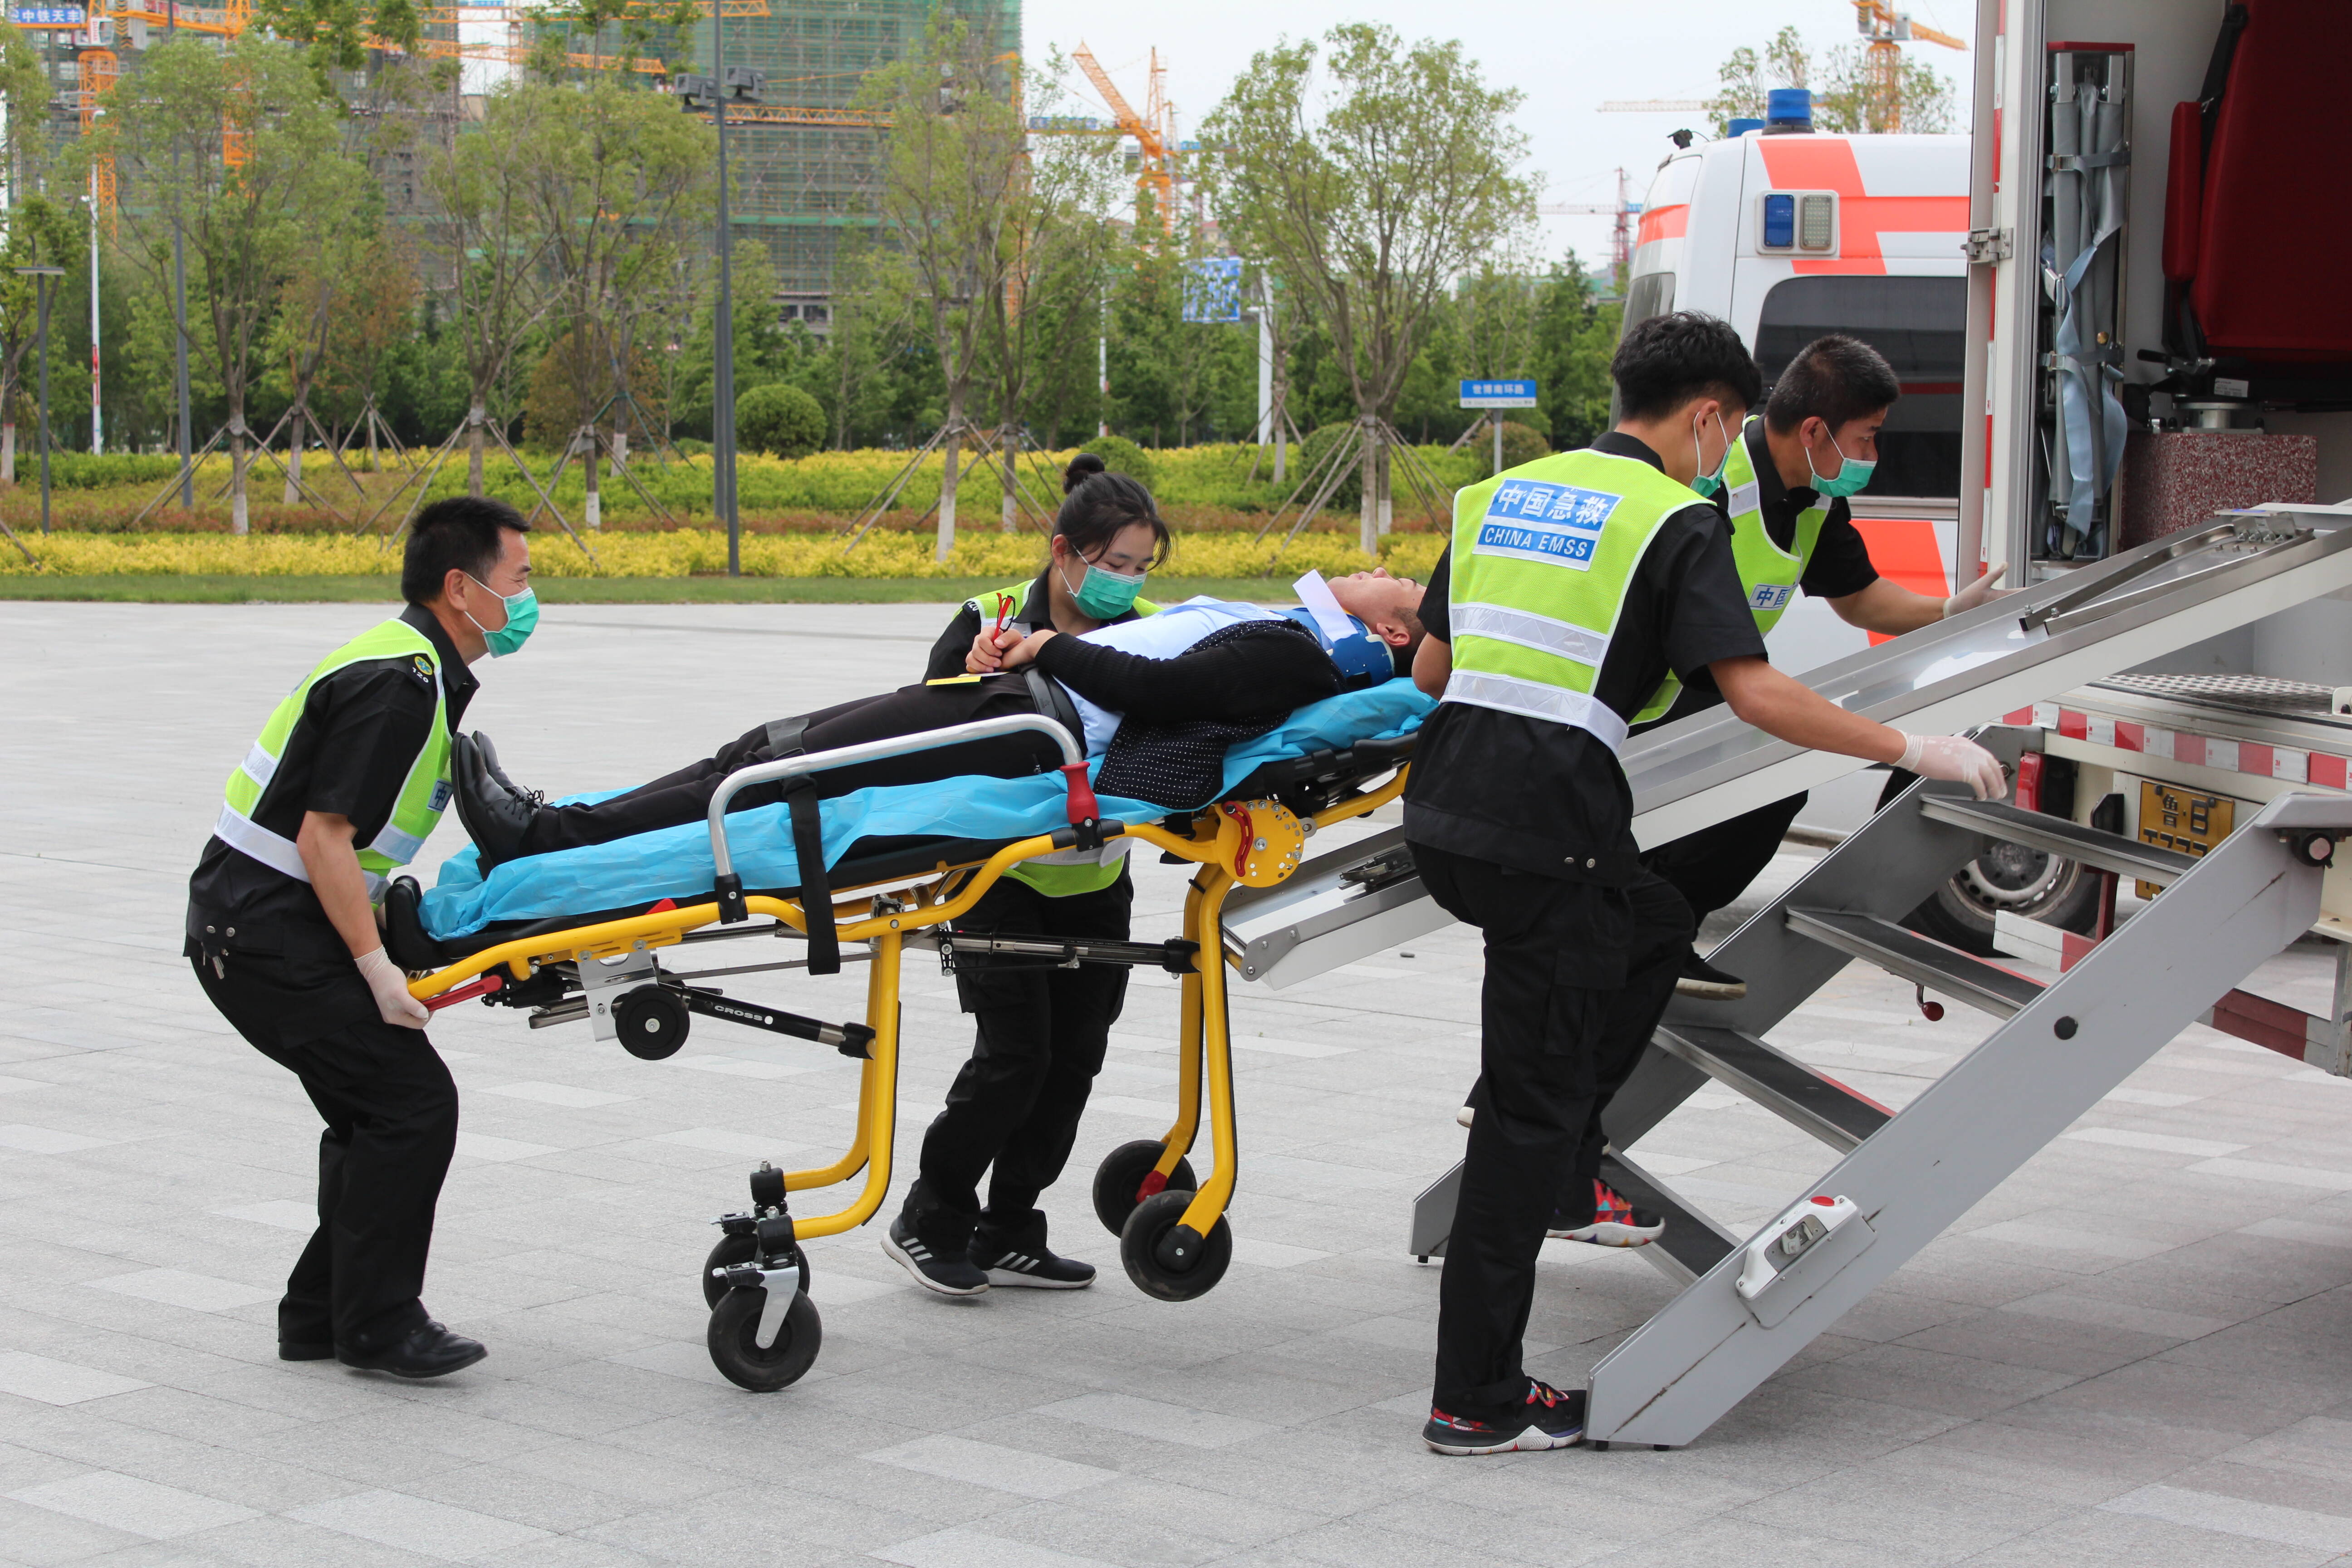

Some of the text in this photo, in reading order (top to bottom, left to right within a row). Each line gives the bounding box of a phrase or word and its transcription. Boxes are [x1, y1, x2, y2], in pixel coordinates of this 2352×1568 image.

[1498, 484, 1609, 526] 中国急救
[1485, 527, 1588, 558] CHINA EMSS
[412, 667, 429, 683] 120
[714, 1005, 763, 1021] CROSS
